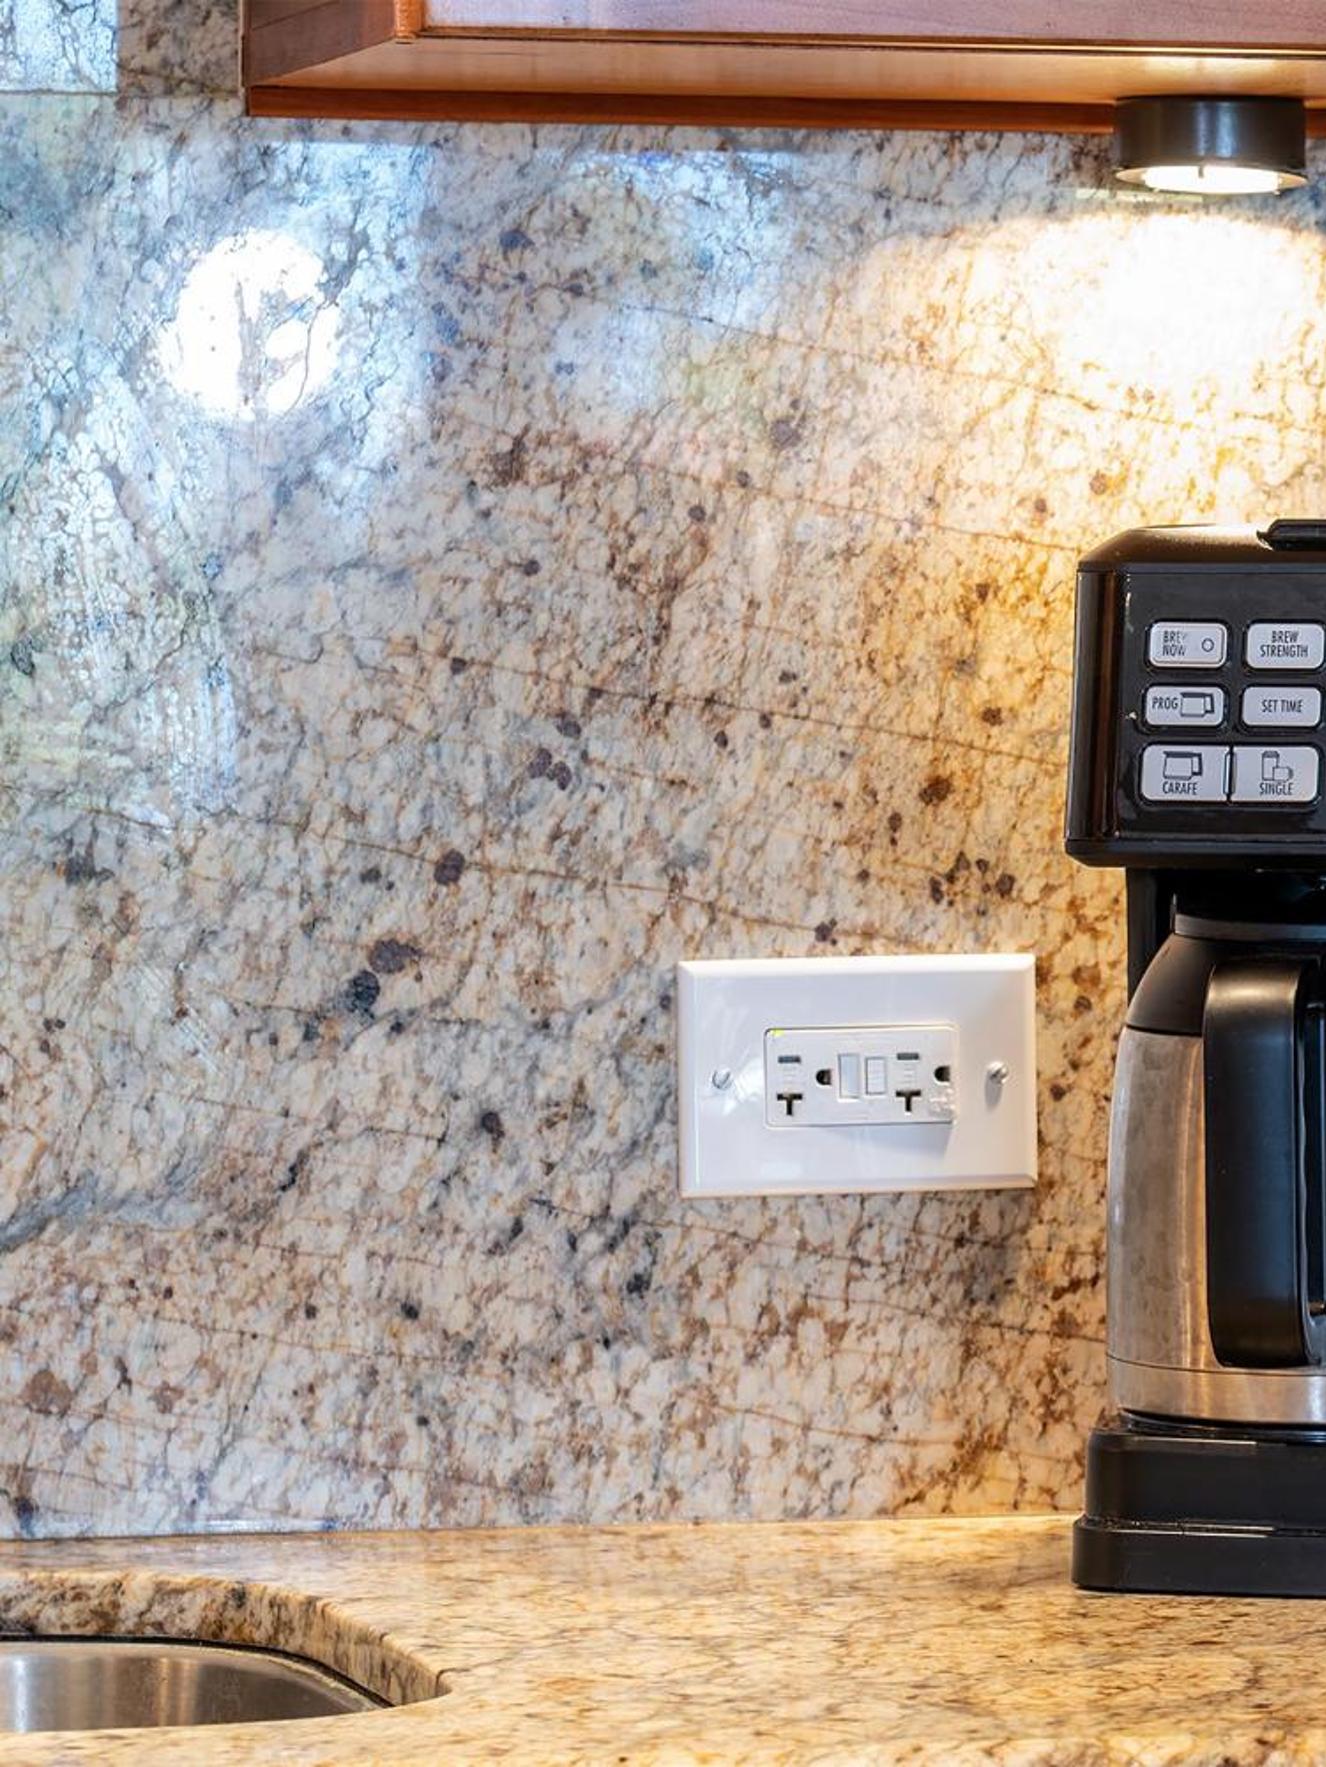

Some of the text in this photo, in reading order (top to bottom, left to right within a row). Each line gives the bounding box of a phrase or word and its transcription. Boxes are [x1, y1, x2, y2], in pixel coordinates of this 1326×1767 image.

[1271, 630, 1298, 643] BREW
[1260, 645, 1308, 658] STRENGTH
[1152, 697, 1178, 710] PROG
[1262, 700, 1303, 713] SET TIME
[1162, 782, 1198, 795] CARAFE
[1259, 782, 1293, 795] SINGLE
